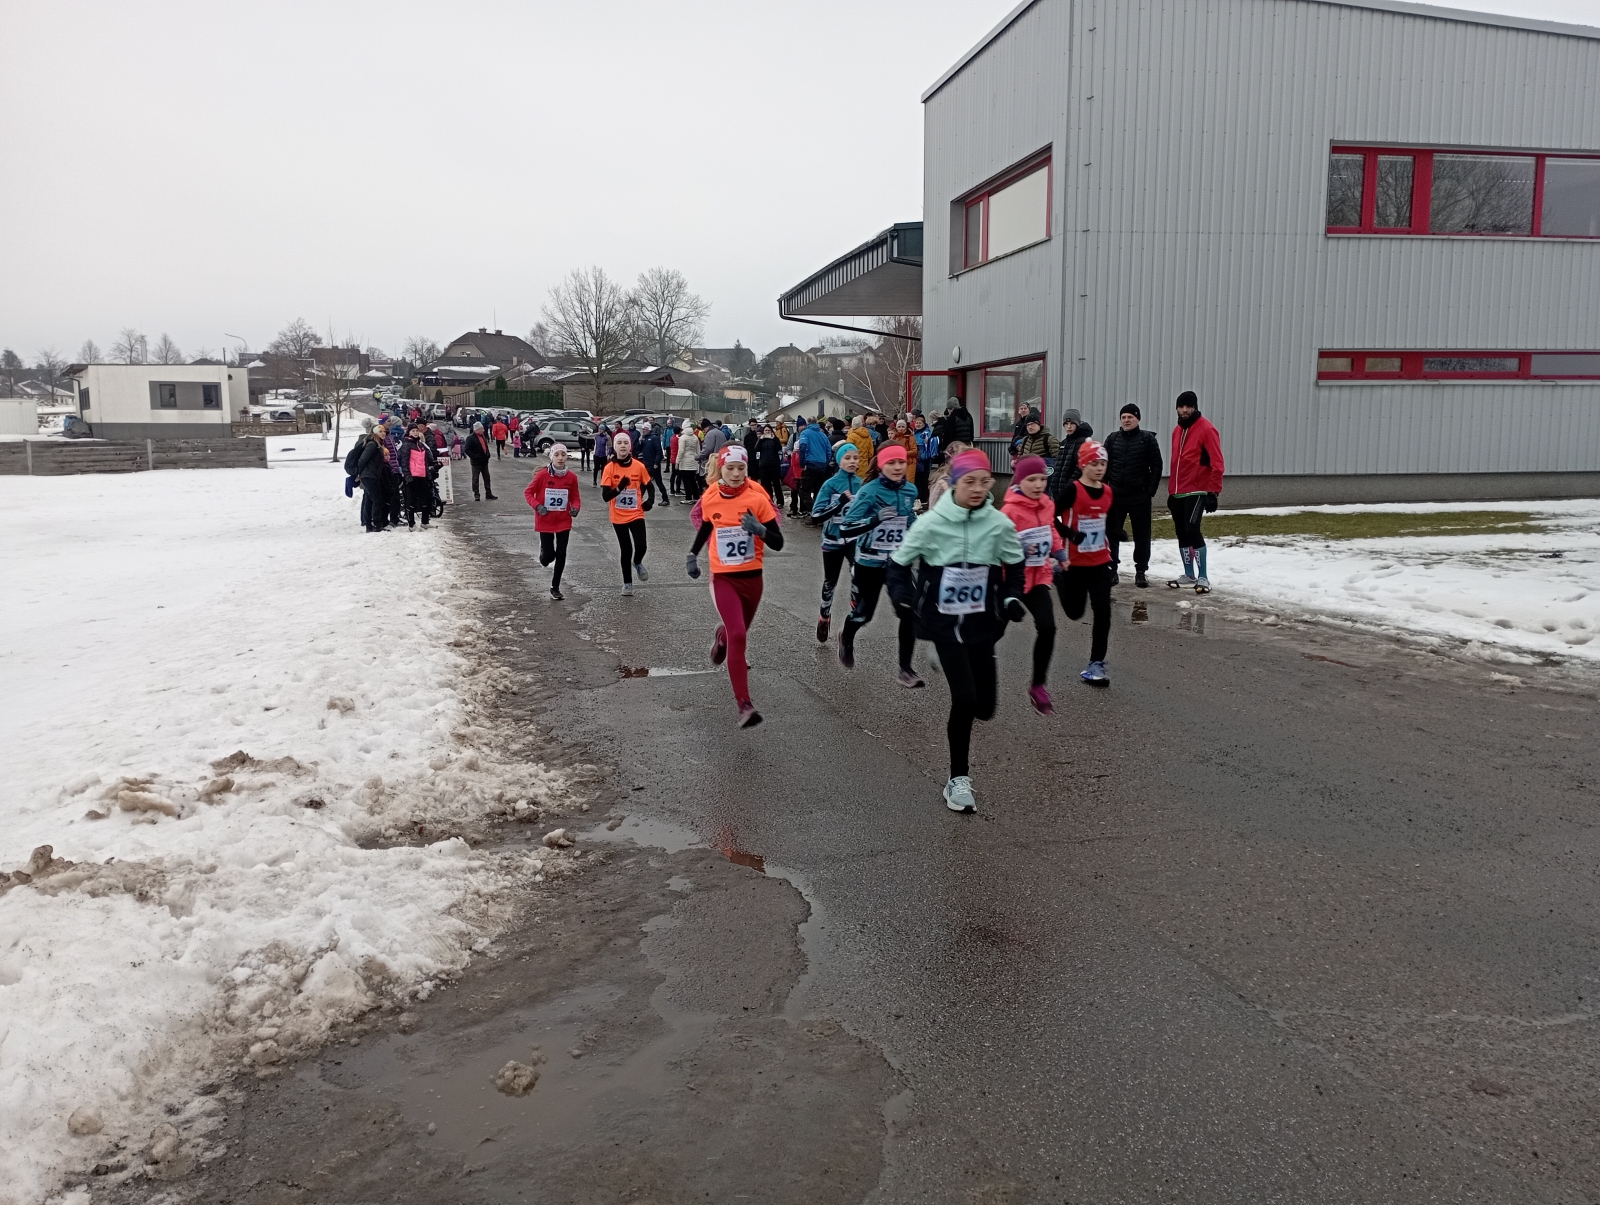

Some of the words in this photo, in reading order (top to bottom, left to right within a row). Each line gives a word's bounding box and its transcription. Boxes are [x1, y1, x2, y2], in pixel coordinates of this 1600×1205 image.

[550, 497, 563, 506] 29
[620, 497, 633, 506] 43
[876, 529, 902, 542] 263
[726, 541, 747, 557] 26
[943, 586, 982, 603] 260
